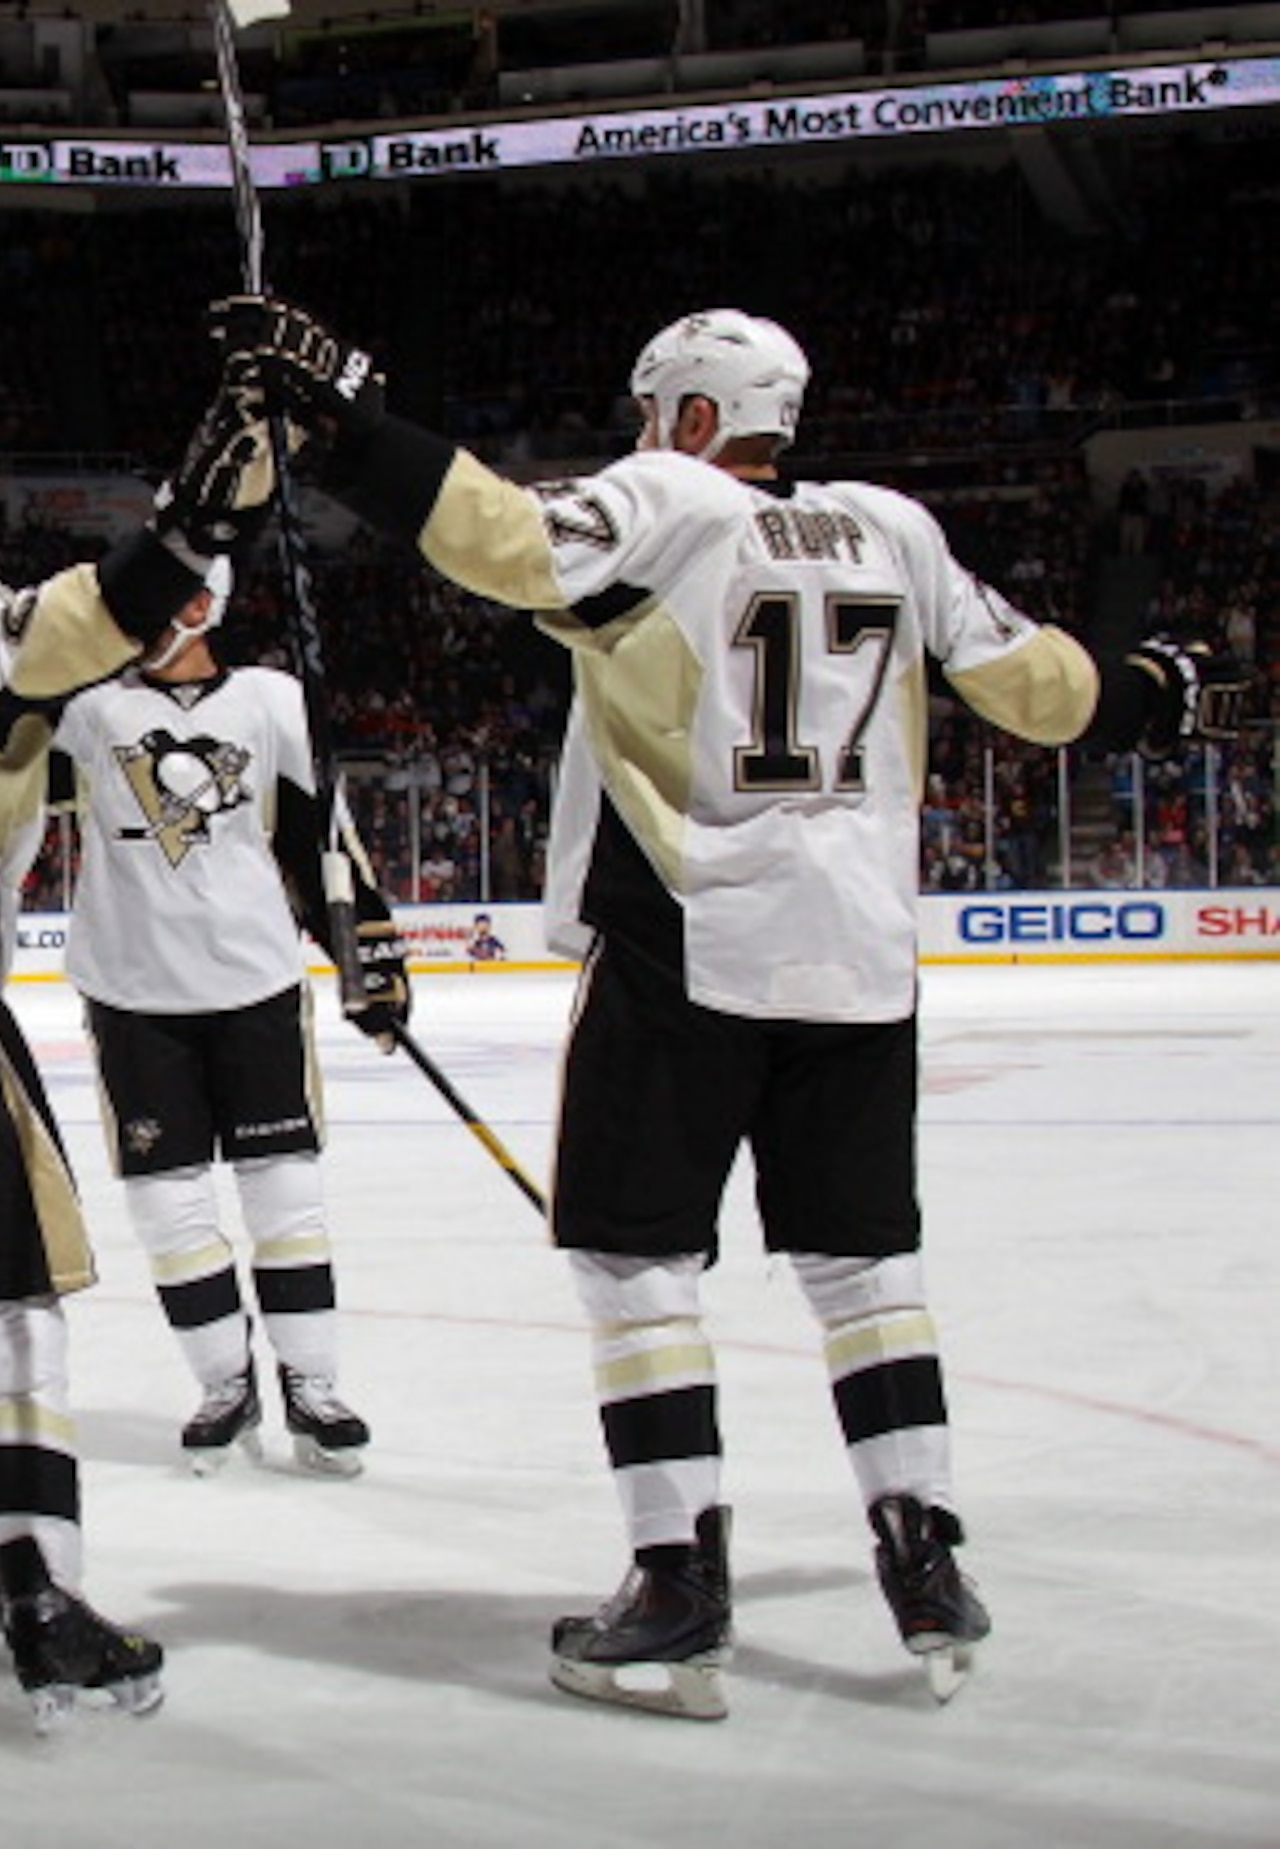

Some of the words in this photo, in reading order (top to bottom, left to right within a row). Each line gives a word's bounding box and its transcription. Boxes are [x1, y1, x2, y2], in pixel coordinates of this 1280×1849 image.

[575, 116, 751, 153] America's
[766, 105, 860, 139] Most
[874, 85, 1095, 126] Convenient
[69, 148, 181, 182] Bank
[387, 135, 498, 170] Bank
[730, 591, 905, 791] 17
[958, 902, 1165, 944] GEICO
